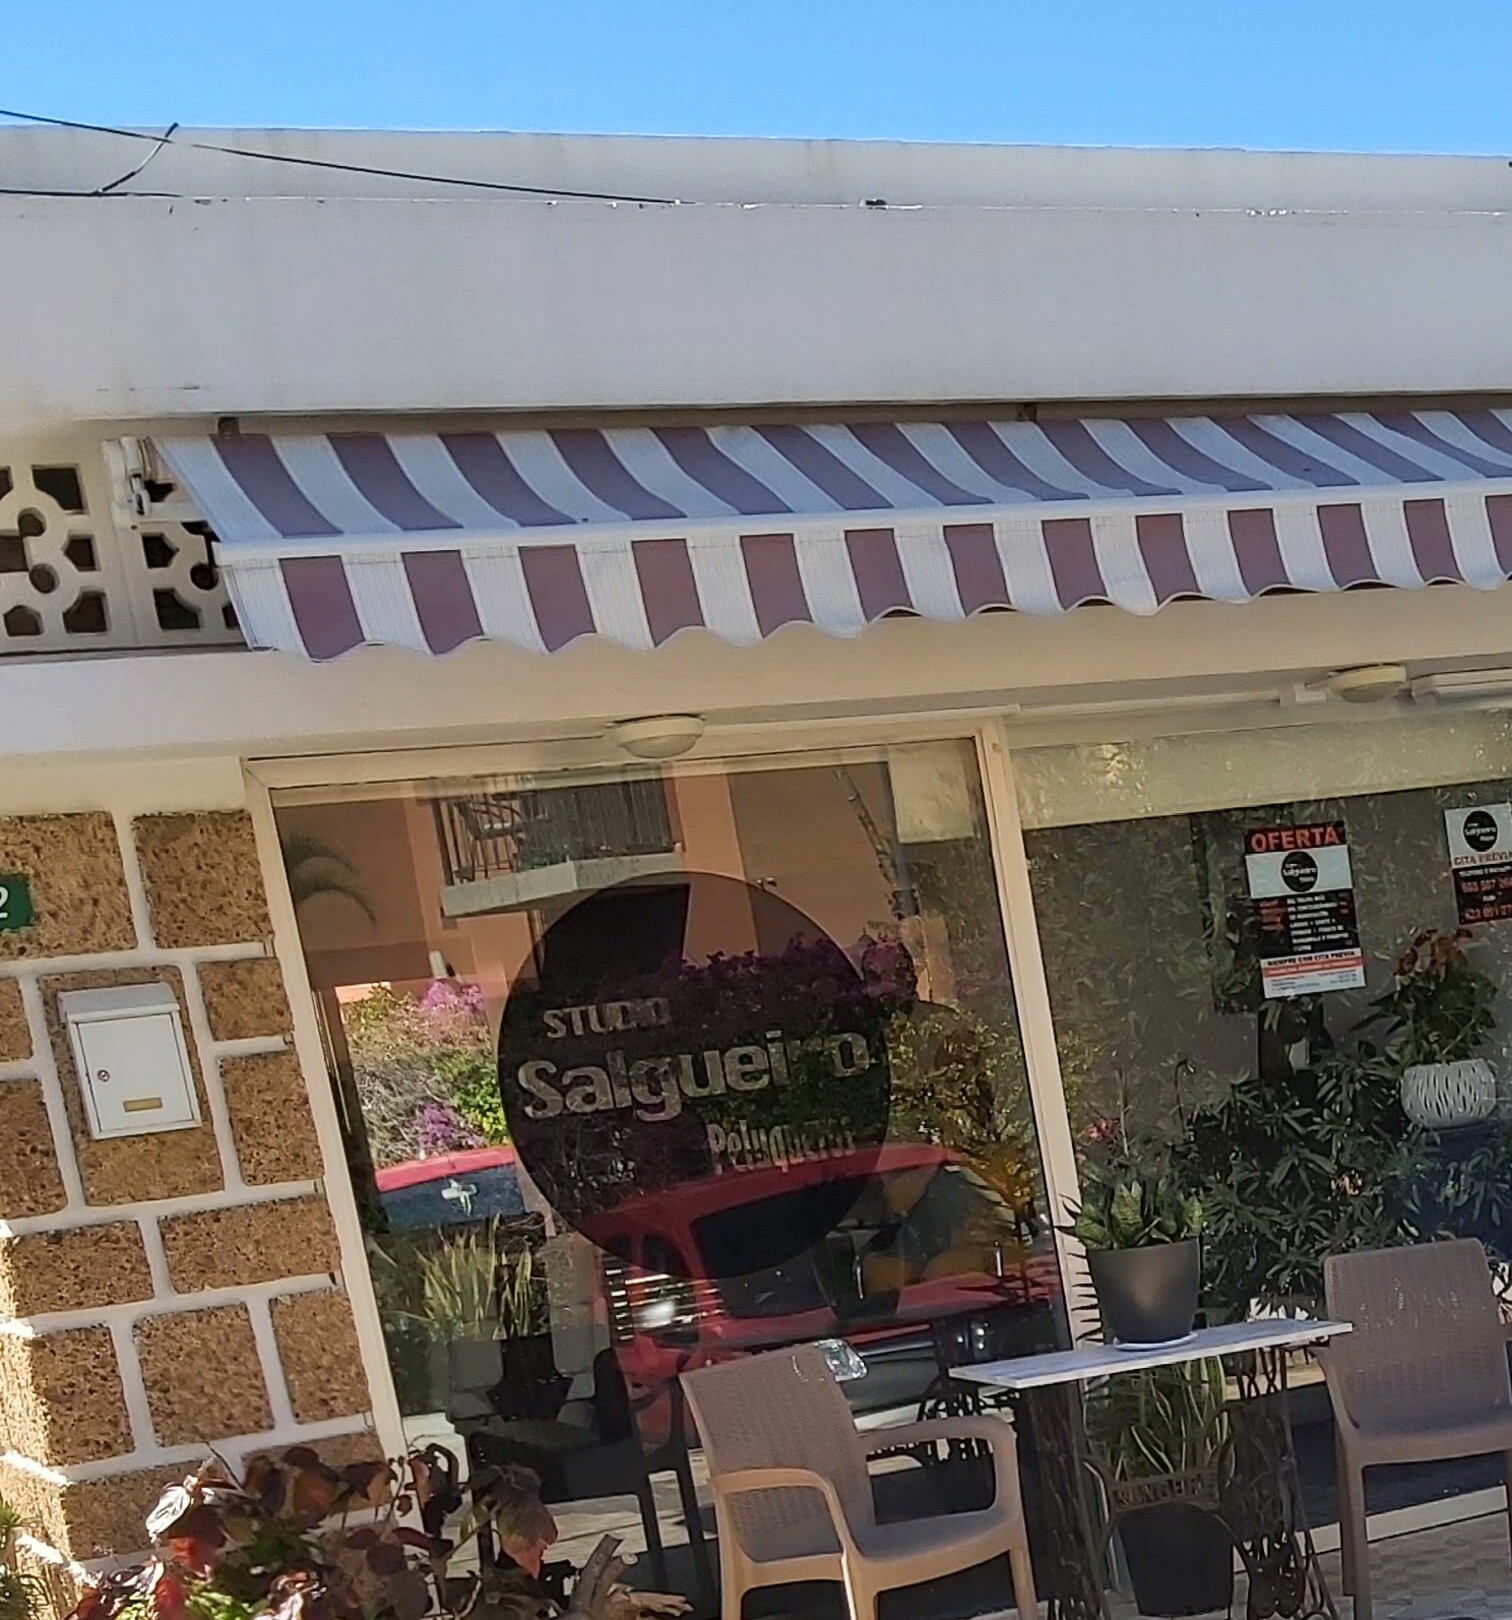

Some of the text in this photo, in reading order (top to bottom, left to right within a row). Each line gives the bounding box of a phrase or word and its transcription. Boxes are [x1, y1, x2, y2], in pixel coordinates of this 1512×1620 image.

[1250, 826, 1340, 852] OFERTA
[1454, 855, 1477, 866] CITA
[543, 998, 672, 1039] STUDIO
[516, 1029, 871, 1122] Salgueiro
